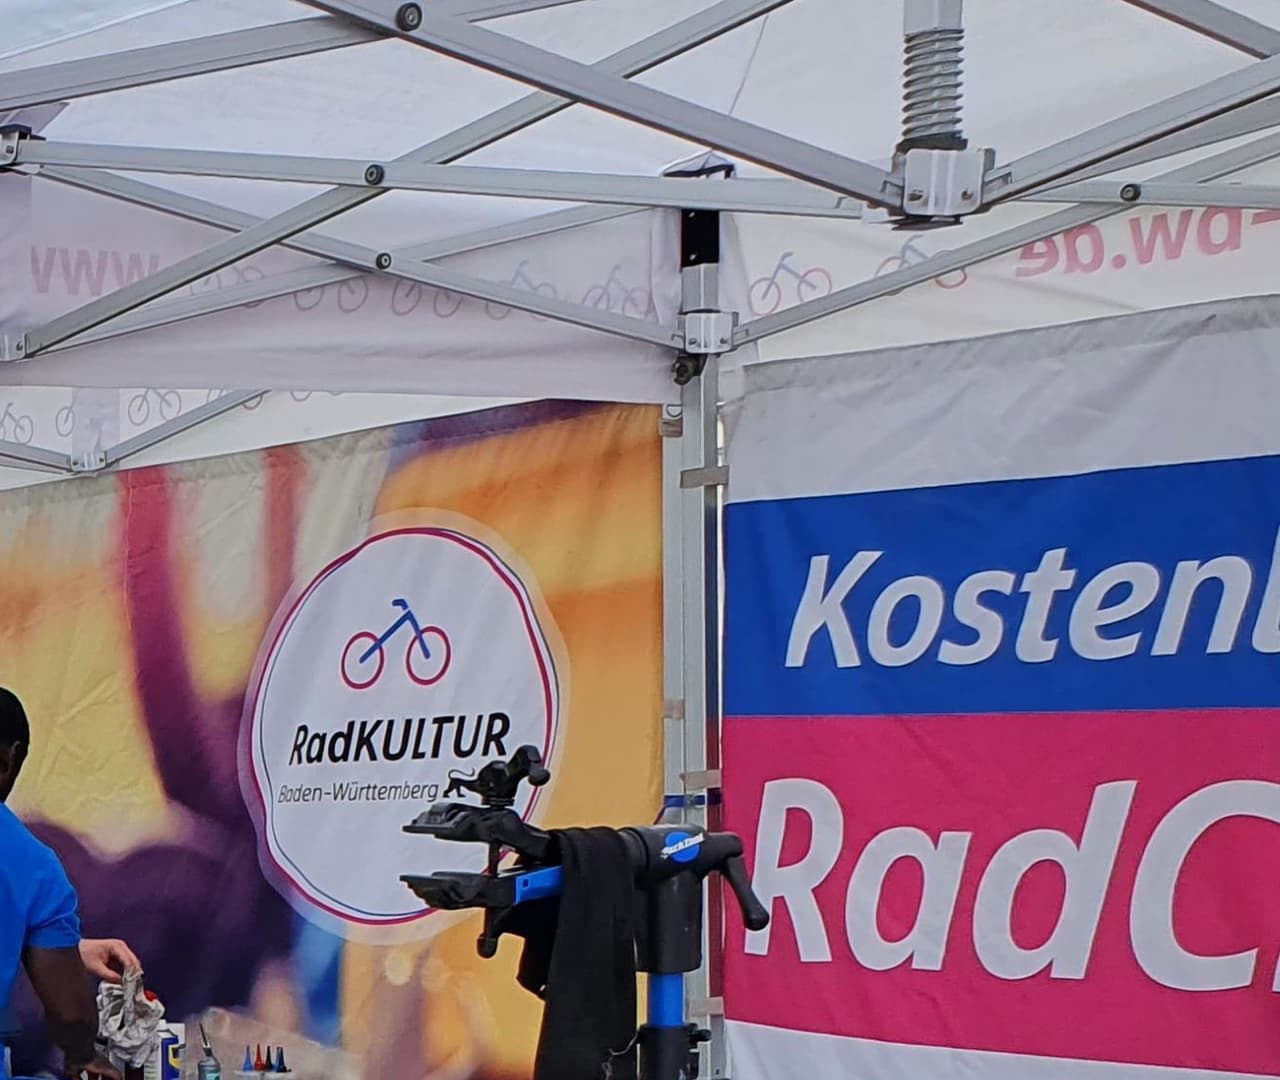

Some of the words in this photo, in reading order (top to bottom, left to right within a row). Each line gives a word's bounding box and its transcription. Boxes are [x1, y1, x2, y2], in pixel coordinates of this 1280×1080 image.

[289, 712, 511, 766] RadKULTUR
[278, 779, 439, 803] Baden-Württemberg
[744, 777, 1280, 992] RadC
